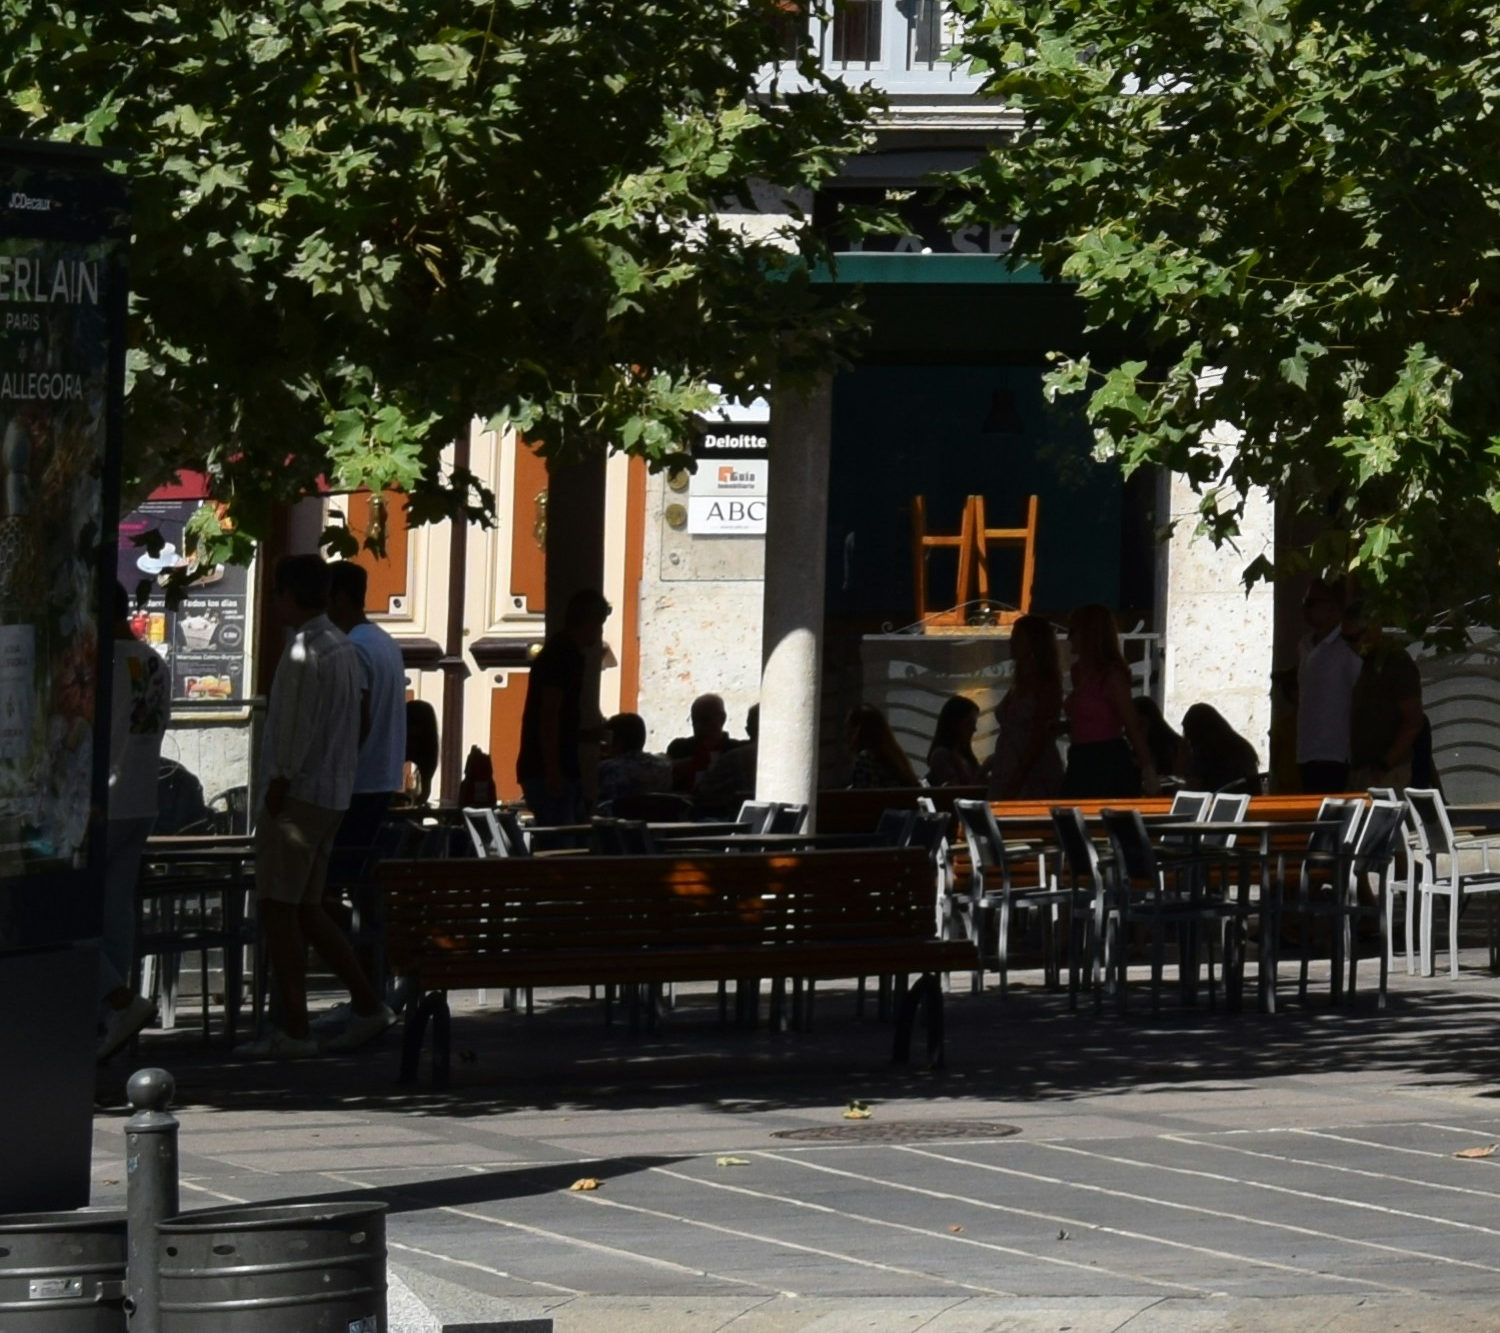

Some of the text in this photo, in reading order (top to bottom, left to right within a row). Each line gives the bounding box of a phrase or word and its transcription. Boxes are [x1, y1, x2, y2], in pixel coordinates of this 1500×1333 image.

[8, 191, 51, 212] JCDecaux
[5, 312, 41, 331] PARIS
[704, 434, 767, 449] Deloitte
[706, 501, 766, 522] ABC
